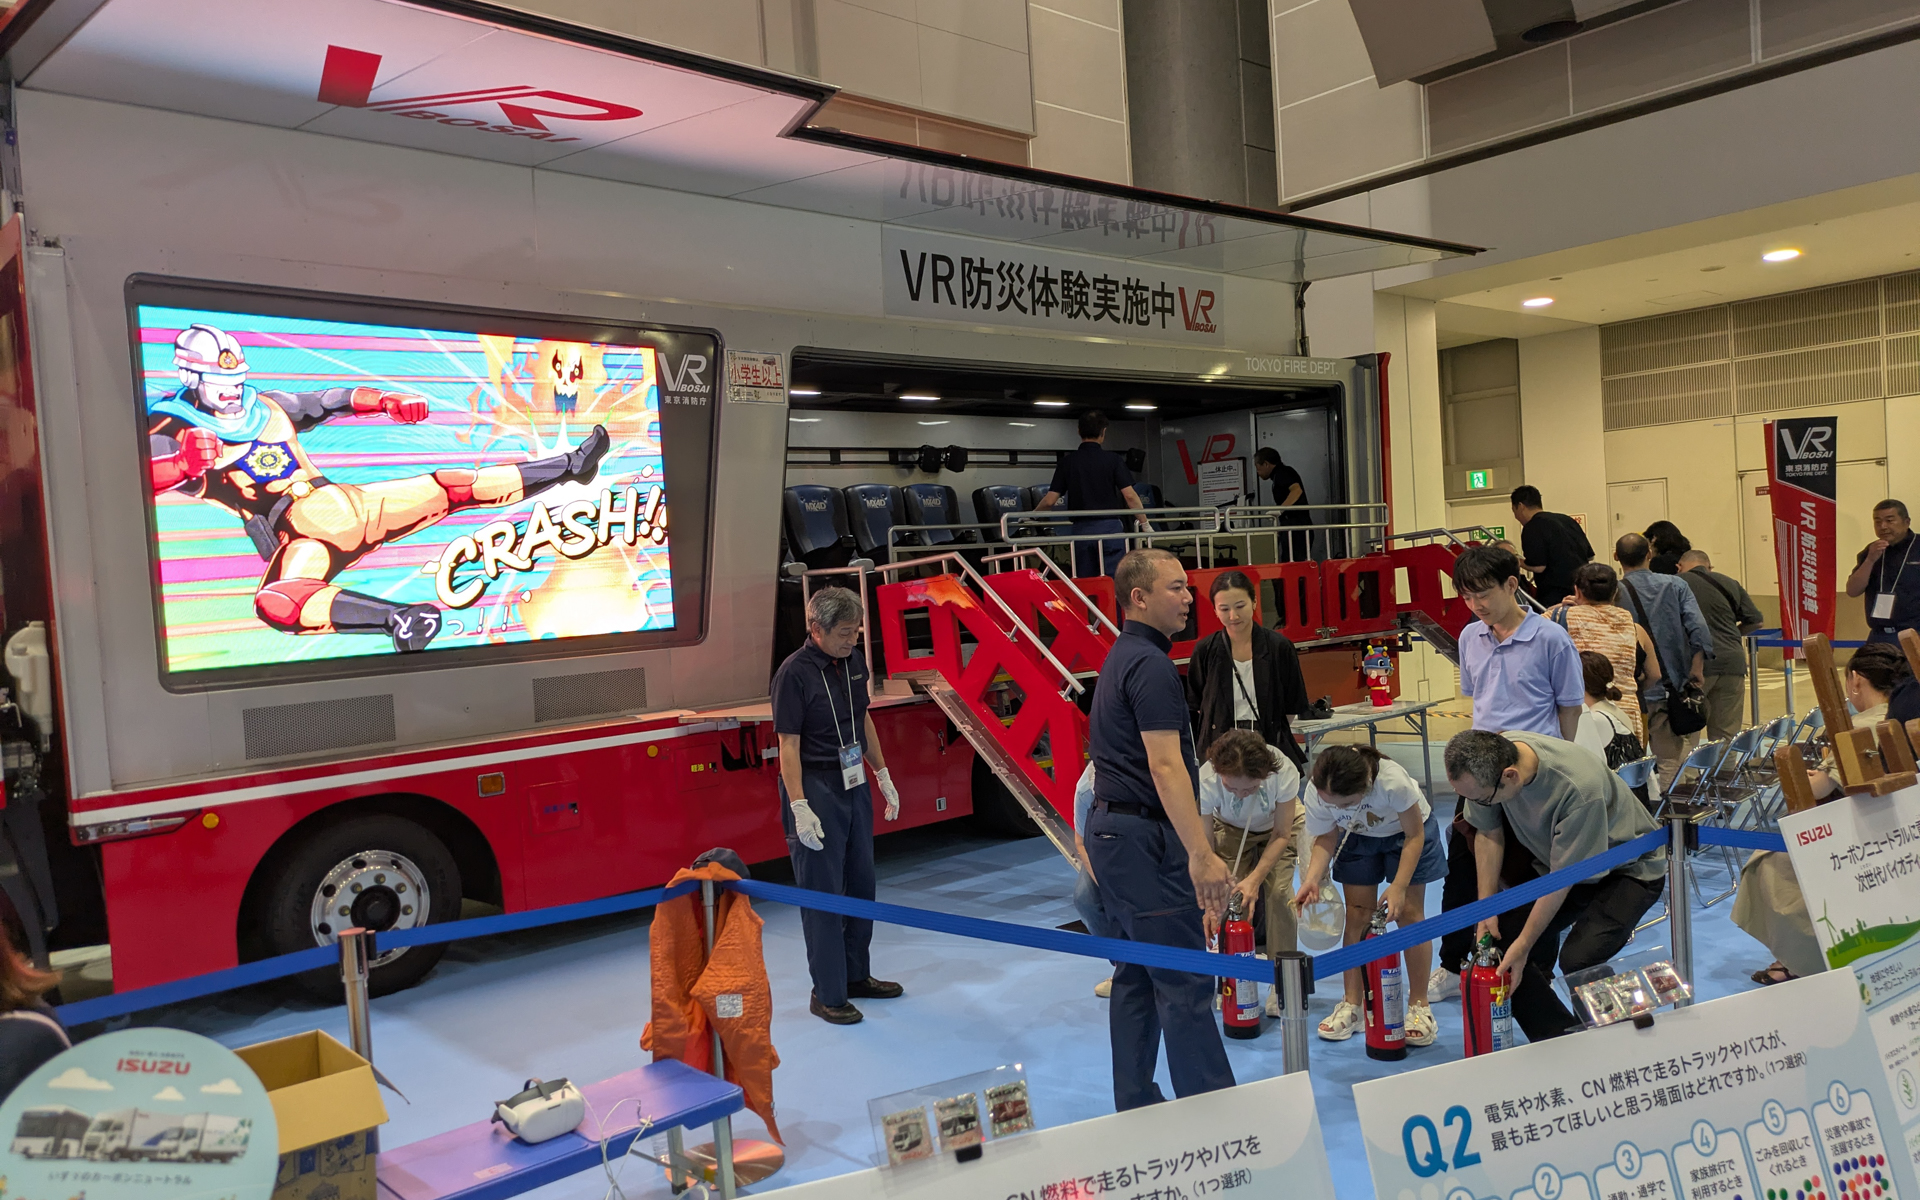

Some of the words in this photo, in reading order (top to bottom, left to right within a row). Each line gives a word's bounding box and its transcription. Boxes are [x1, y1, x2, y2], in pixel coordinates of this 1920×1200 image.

[317, 44, 643, 132] VR
[392, 110, 582, 142] BOSAI
[899, 249, 1176, 329] VR防災体験実施中
[1178, 286, 1216, 331] VR
[1194, 322, 1217, 334] BOSAI
[657, 352, 707, 392] VR
[730, 363, 783, 387] 小学生以上
[1245, 357, 1282, 373] TOKYO
[1284, 359, 1307, 374] FIRE
[1310, 361, 1338, 375] DEPT.
[664, 395, 707, 406] 東京消防庁
[681, 384, 710, 393] BOSAI
[1780, 426, 1832, 460] VR
[1802, 450, 1834, 459] BOSAI
[1785, 463, 1829, 472] 東京消防庁
[1800, 501, 1819, 615] VR防災体験車
[1796, 822, 1833, 847] ISUZU
[116, 1058, 191, 1076] ISUZU
[1836, 1087, 1845, 1109] 6
[1768, 1107, 1780, 1129] 5
[1824, 1116, 1872, 1141] 災害や事故で
[1402, 1105, 1482, 1178] Q2
[1700, 1127, 1711, 1149] 4
[1755, 1135, 1812, 1162] ごみを回収して
[1830, 1132, 1876, 1157] 活躍するとき
[1622, 1149, 1634, 1172] 3
[1690, 1159, 1735, 1182] 家族旅行で
[1769, 1155, 1808, 1176] くれるとき
[1541, 1171, 1555, 1196] 2
[1691, 1175, 1743, 1200] 利用するとき
